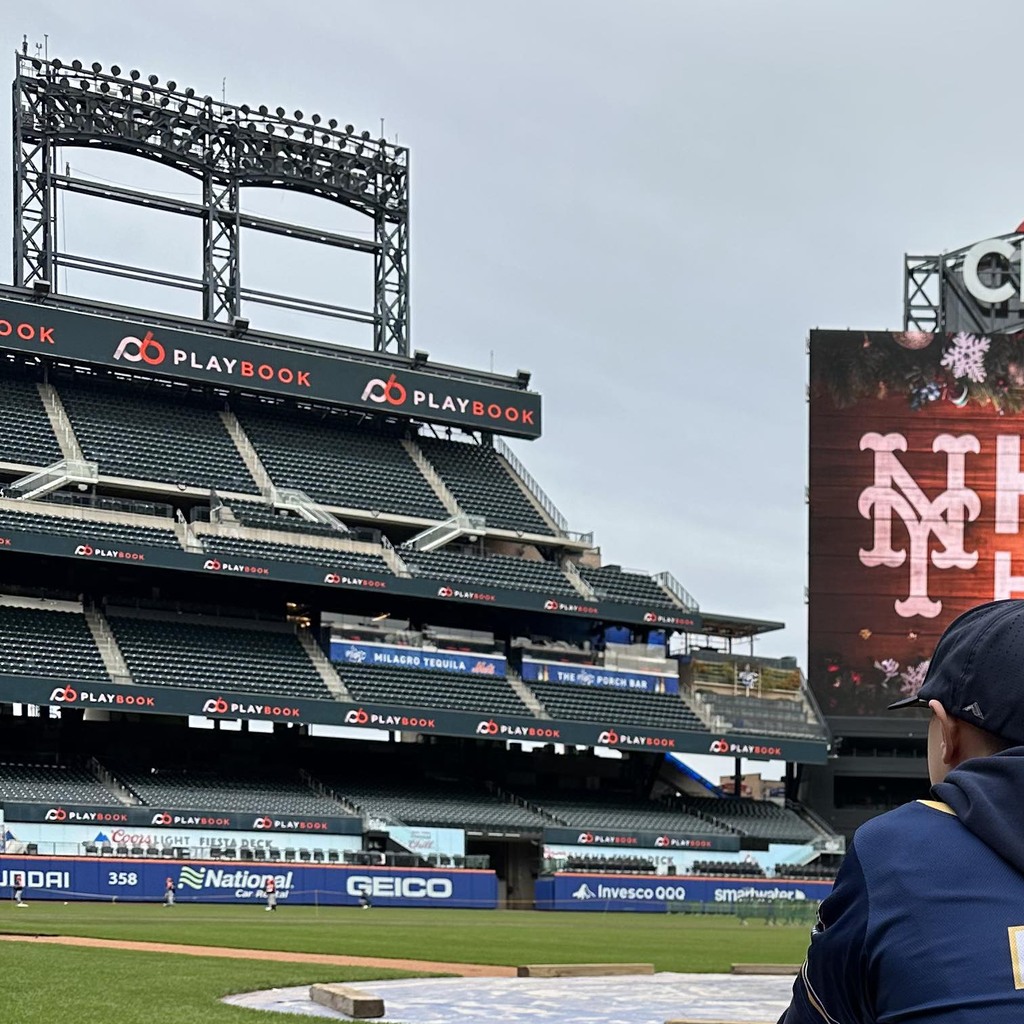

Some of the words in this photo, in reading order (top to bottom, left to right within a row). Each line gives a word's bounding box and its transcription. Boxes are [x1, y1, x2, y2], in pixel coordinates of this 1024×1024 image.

[173, 349, 311, 387] PLAYBOOK
[413, 390, 534, 425] PLAYBOOK
[95, 549, 145, 561] PLAYBOOK
[222, 563, 270, 575] PLAYBOOK
[341, 576, 386, 588] PLAYBOOK
[373, 652, 420, 666] MILAGRO
[423, 657, 466, 671] TEQUILA
[557, 671, 575, 682] THE
[596, 675, 627, 687] PORCH
[629, 679, 648, 689] BAR
[80, 691, 155, 707] PLAYBOOK
[230, 703, 300, 717] PLAYBOOK
[370, 714, 435, 728] PLAYBOOK
[500, 724, 560, 738] PLAYBOOK
[620, 734, 675, 748] PLAYBOOK
[730, 743, 781, 755] PLAYBOOK
[68, 812, 128, 822] PLAYBOOK
[173, 816, 230, 826] PLAYBOOK
[274, 820, 328, 830] PLAYBOOK
[111, 829, 151, 845] Coors
[154, 835, 191, 847] LIGHT
[199, 836, 237, 848] FIESTA
[241, 838, 273, 849] DECK
[108, 872, 138, 886] 358
[235, 889, 253, 898] Car
[346, 875, 453, 898] GEICO
[597, 884, 653, 899] Invesco
[655, 886, 686, 900] QQQ
